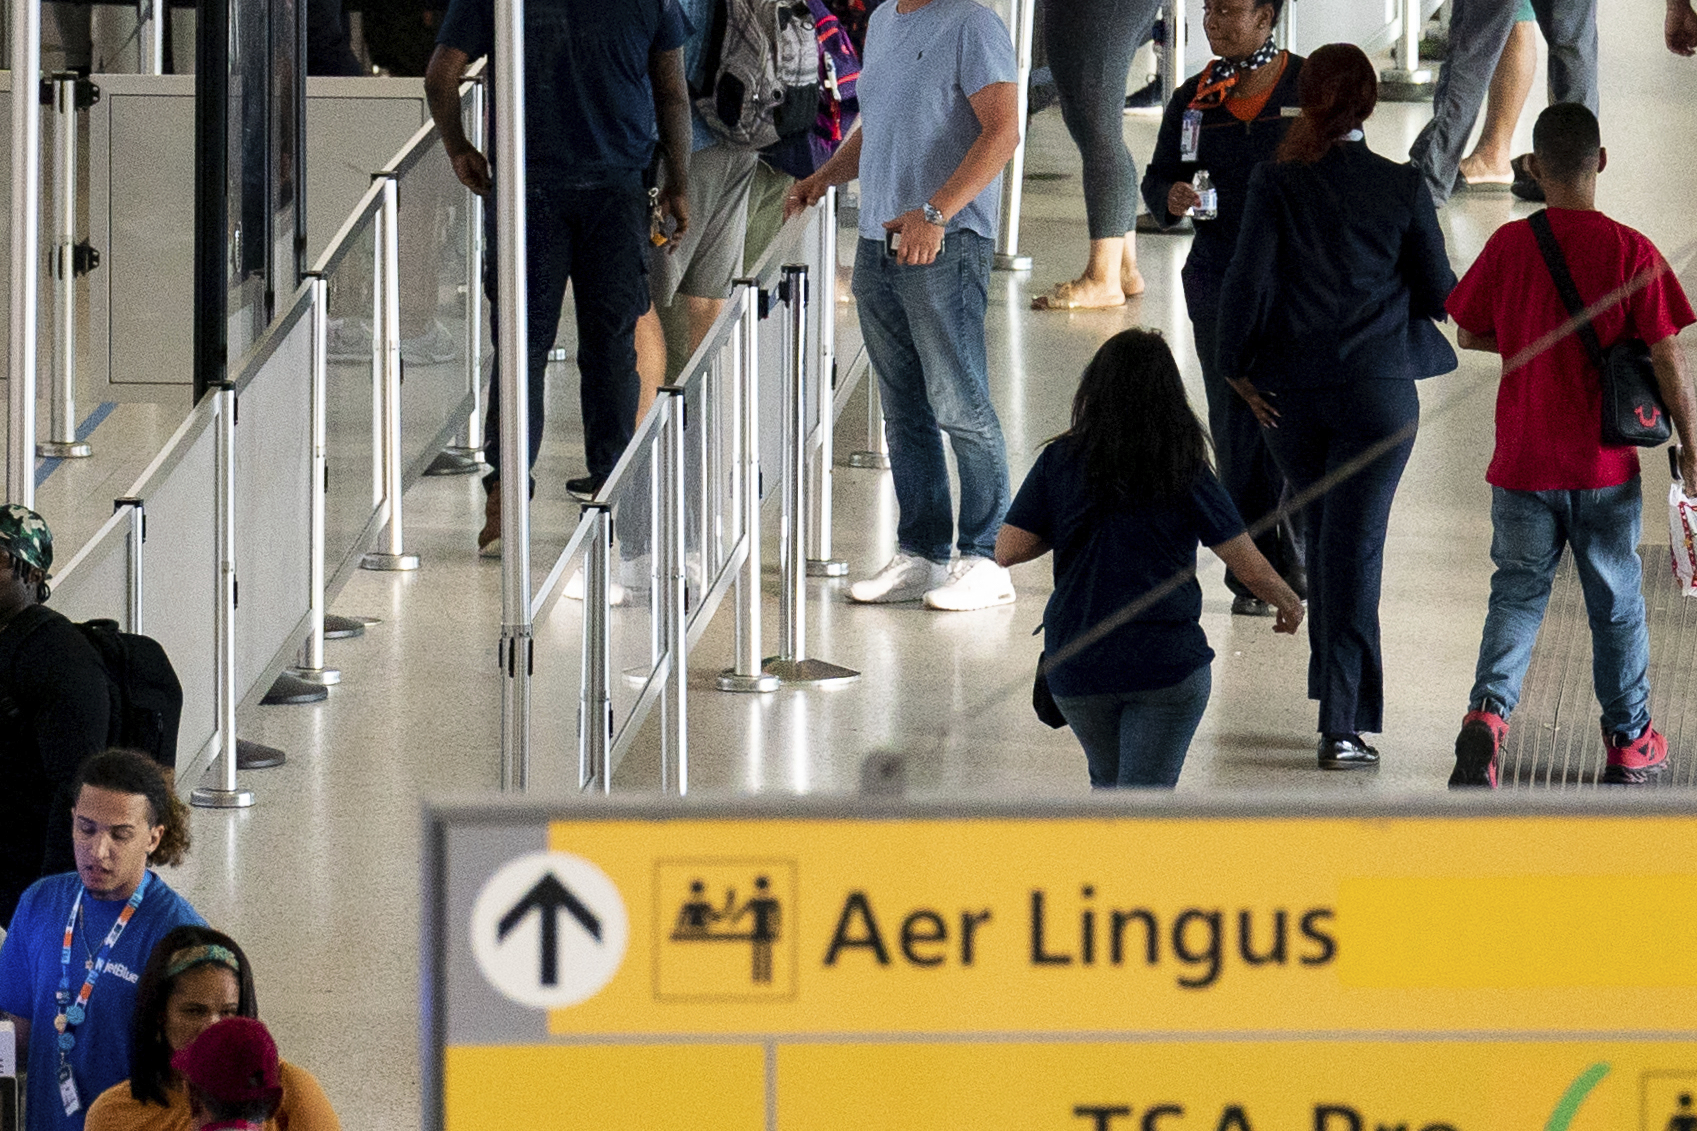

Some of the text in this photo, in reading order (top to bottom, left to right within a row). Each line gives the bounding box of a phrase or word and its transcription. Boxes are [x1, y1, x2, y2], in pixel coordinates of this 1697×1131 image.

[823, 886, 1337, 989] Aer Lingus
[104, 960, 140, 983] jetBlue
